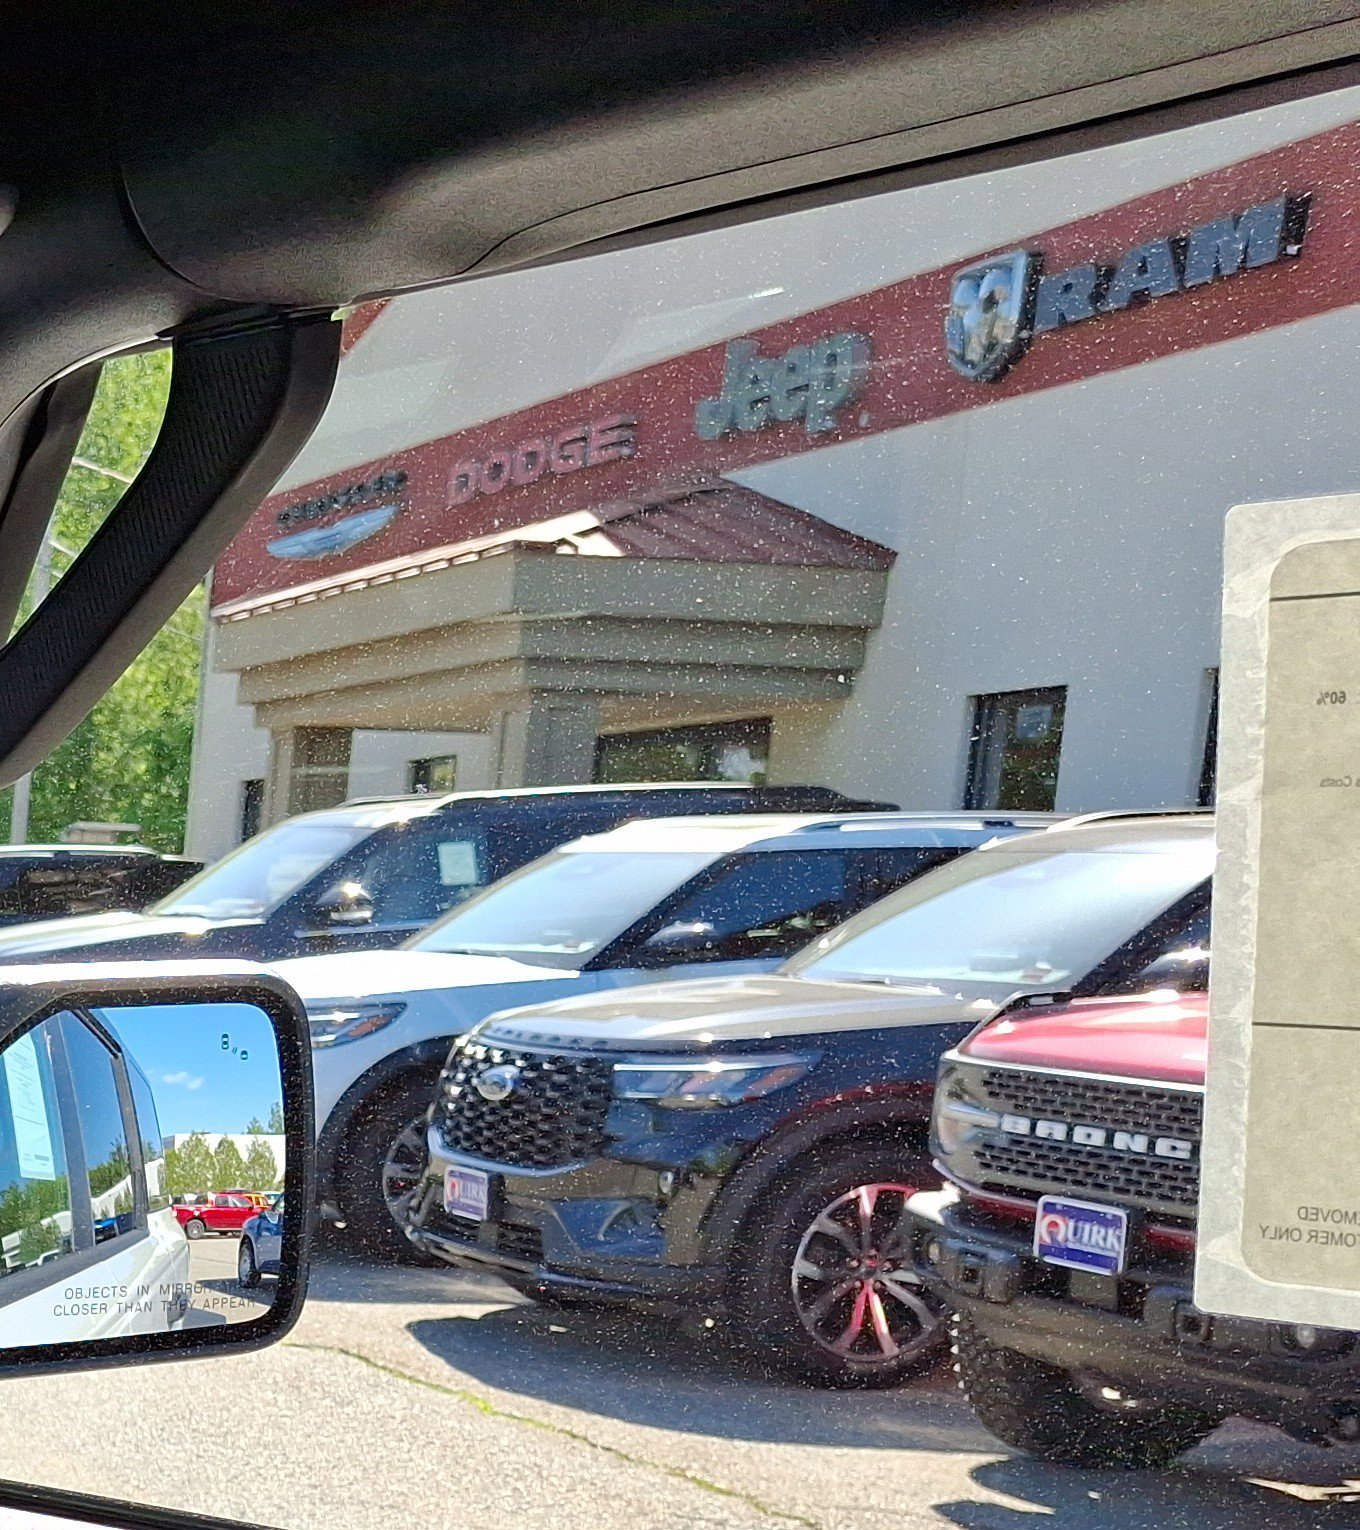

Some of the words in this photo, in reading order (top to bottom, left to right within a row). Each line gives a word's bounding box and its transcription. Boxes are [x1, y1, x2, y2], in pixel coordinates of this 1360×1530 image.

[1033, 196, 1288, 335] RAM
[695, 332, 874, 440] Jeep
[445, 412, 637, 510] DODGE
[1000, 1113, 1193, 1160] BRONC
[1039, 1212, 1121, 1251] QUIRK
[53, 1302, 108, 1317] CLOSER
[117, 1301, 152, 1313] THAN
[161, 1298, 196, 1312] THEY
[203, 1297, 257, 1309] APPEAR
[64, 1285, 128, 1300] OBJECTS
[137, 1284, 151, 1296] IN
